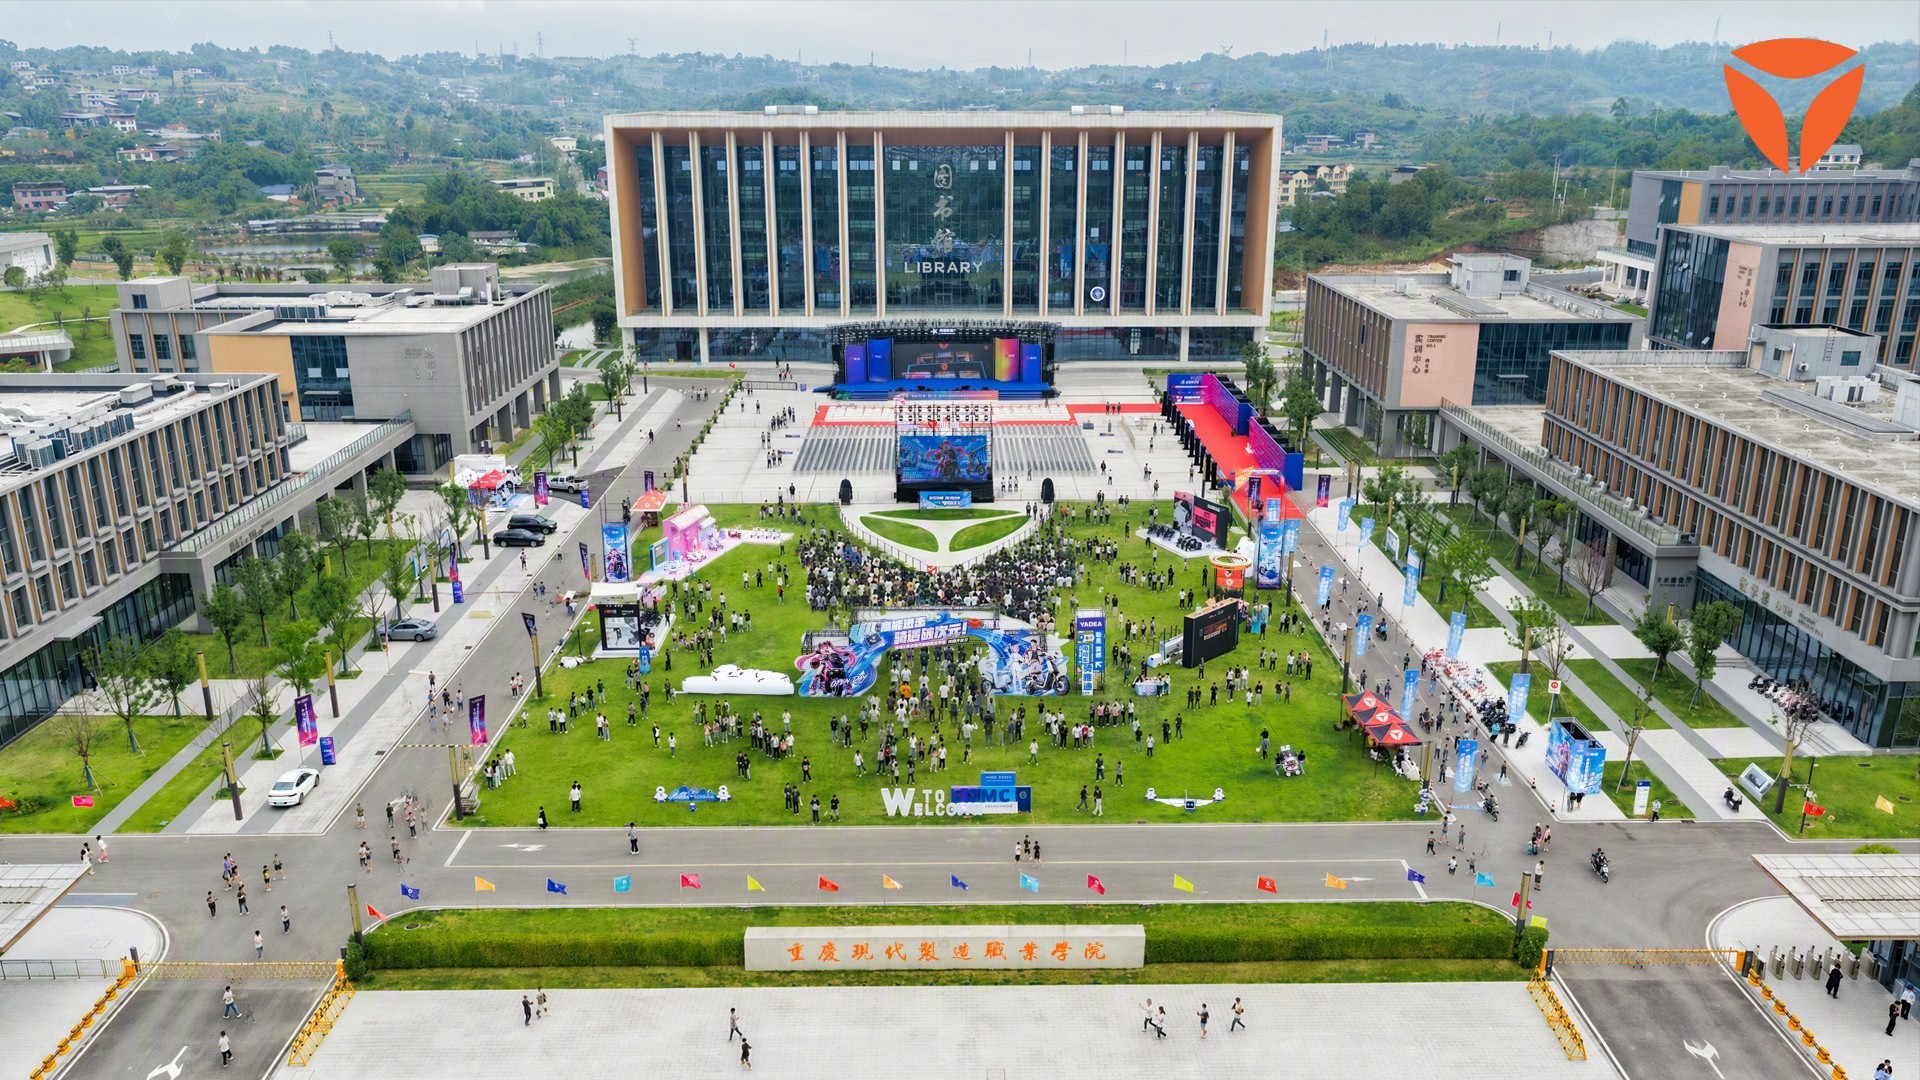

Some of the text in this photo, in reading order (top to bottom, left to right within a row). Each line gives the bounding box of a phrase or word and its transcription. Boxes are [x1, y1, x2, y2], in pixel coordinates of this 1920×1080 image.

[933, 163, 956, 253] 图书馆
[904, 261, 983, 274] LIBRARY
[1412, 334, 1424, 374] 实训中心
[922, 789, 945, 803] TO
[788, 942, 1105, 962] 重慶現代製造職業學院
